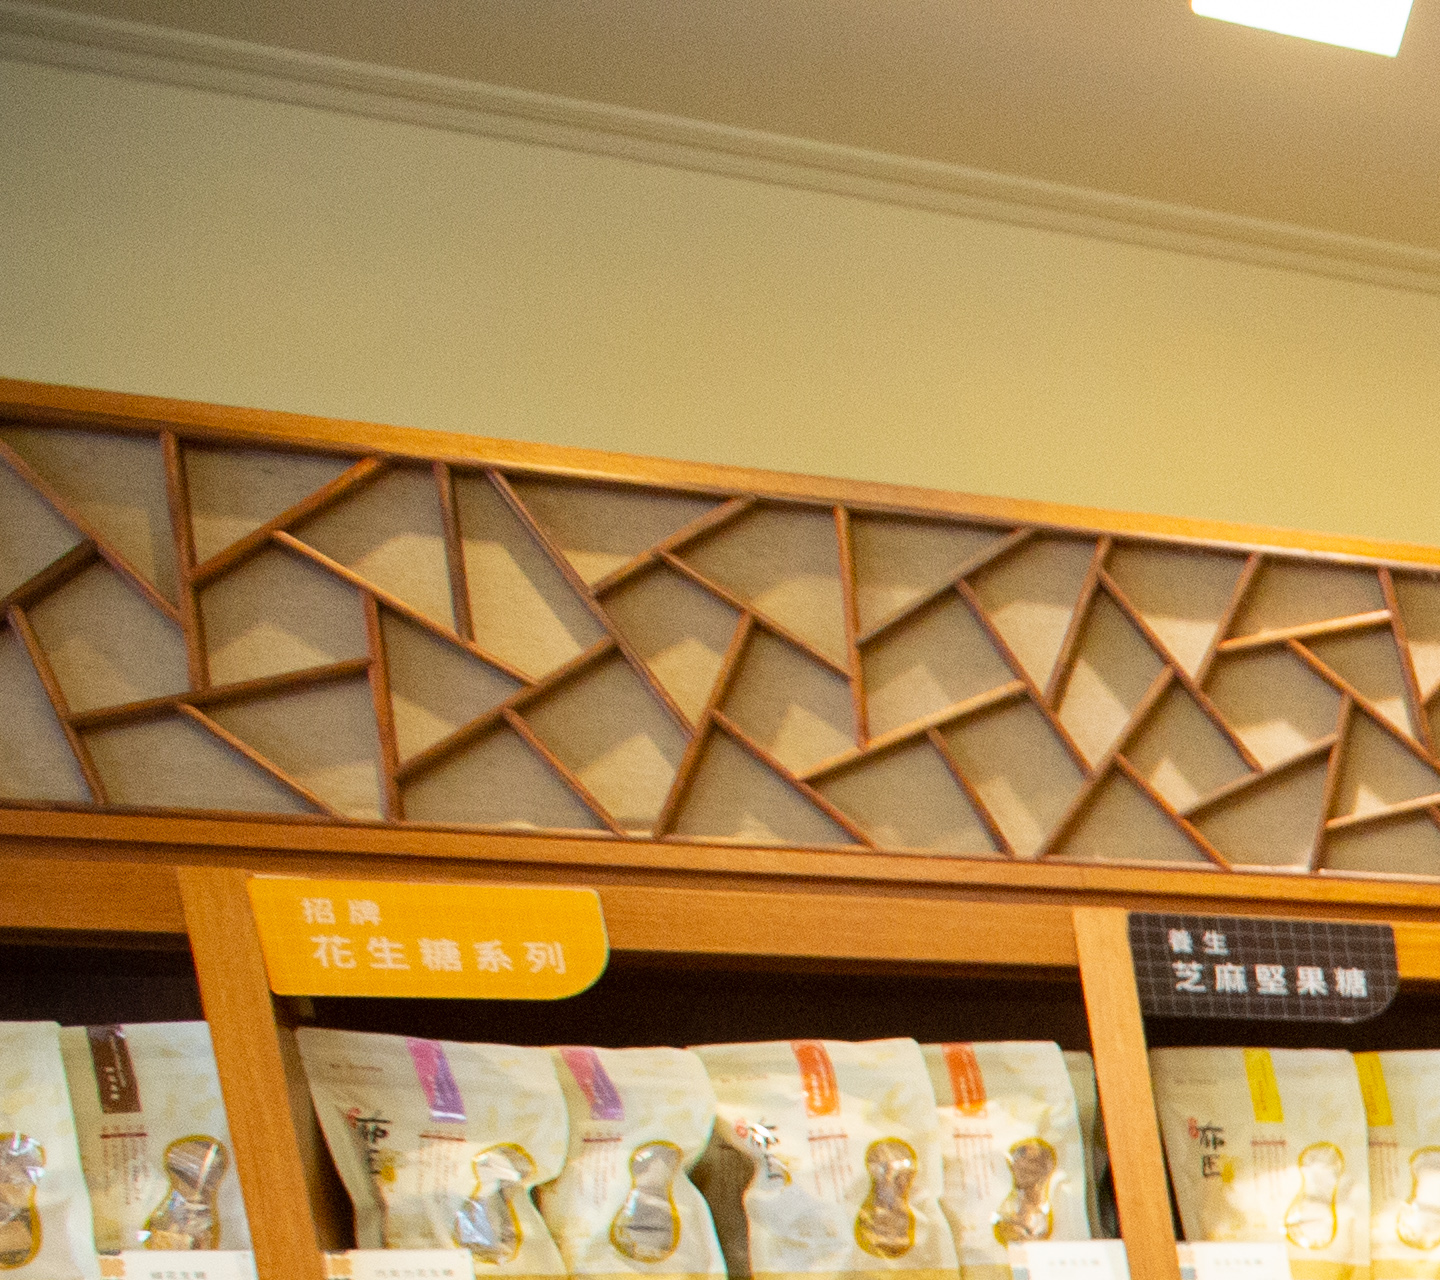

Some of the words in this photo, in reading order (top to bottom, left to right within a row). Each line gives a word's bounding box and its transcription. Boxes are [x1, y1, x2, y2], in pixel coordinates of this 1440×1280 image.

[302, 897, 383, 927] 招牌
[311, 935, 567, 975] 花生糖系列
[1169, 928, 1229, 958] 養生
[1173, 961, 1369, 999] 芝麻堅果糖
